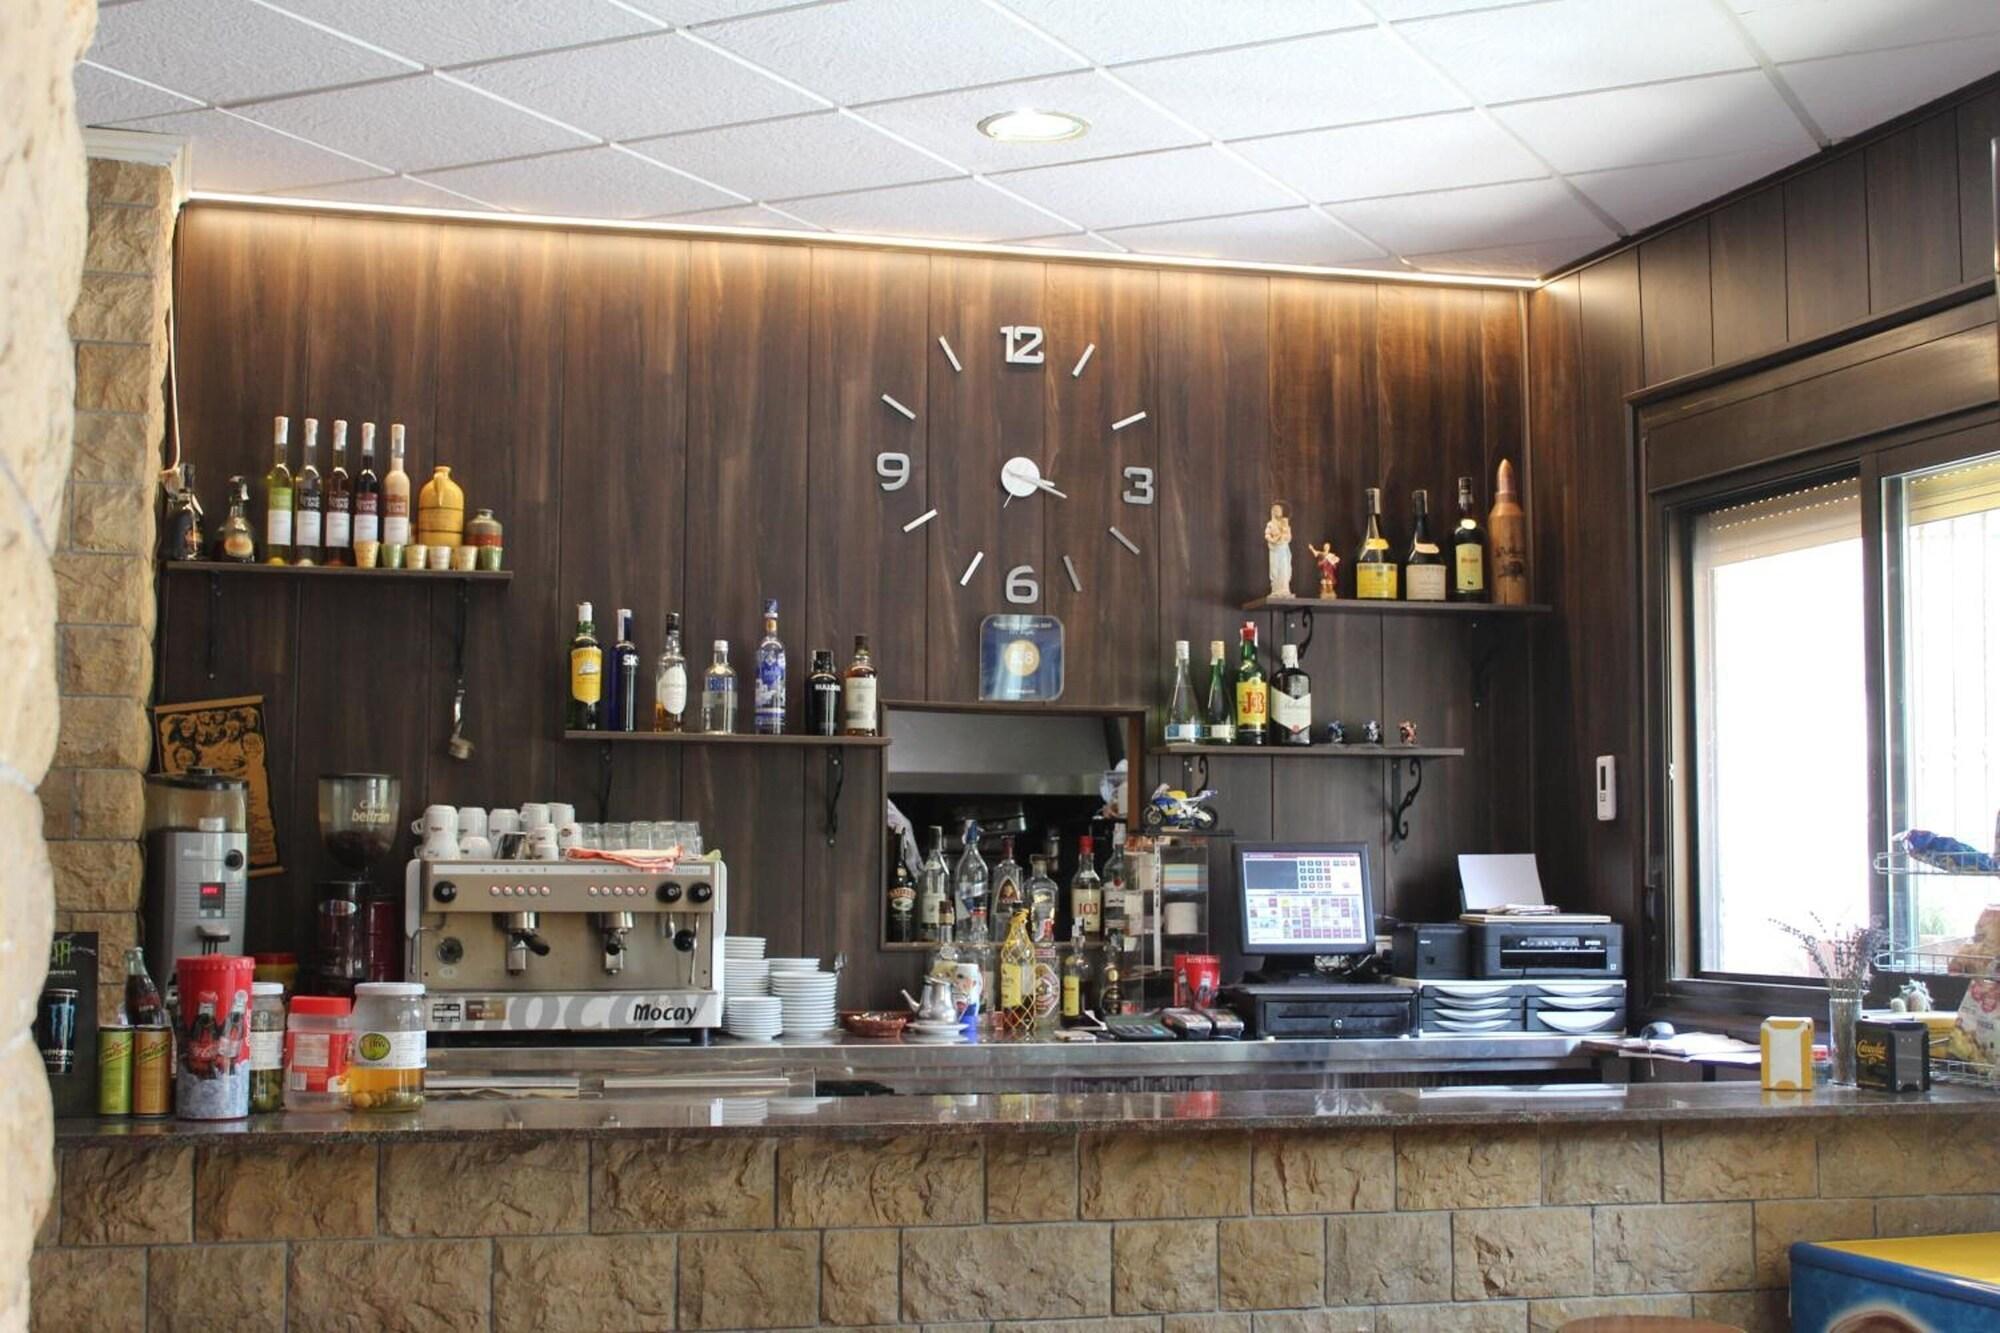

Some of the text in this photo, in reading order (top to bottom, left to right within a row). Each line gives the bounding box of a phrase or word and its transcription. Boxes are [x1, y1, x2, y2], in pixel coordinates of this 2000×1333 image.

[1000, 326, 1044, 364] 12
[876, 452, 910, 491] 9
[1122, 466, 1154, 504] 3
[1005, 565, 1038, 604] 6
[1077, 902, 1099, 916] 103
[633, 1003, 697, 1025] Mocay
